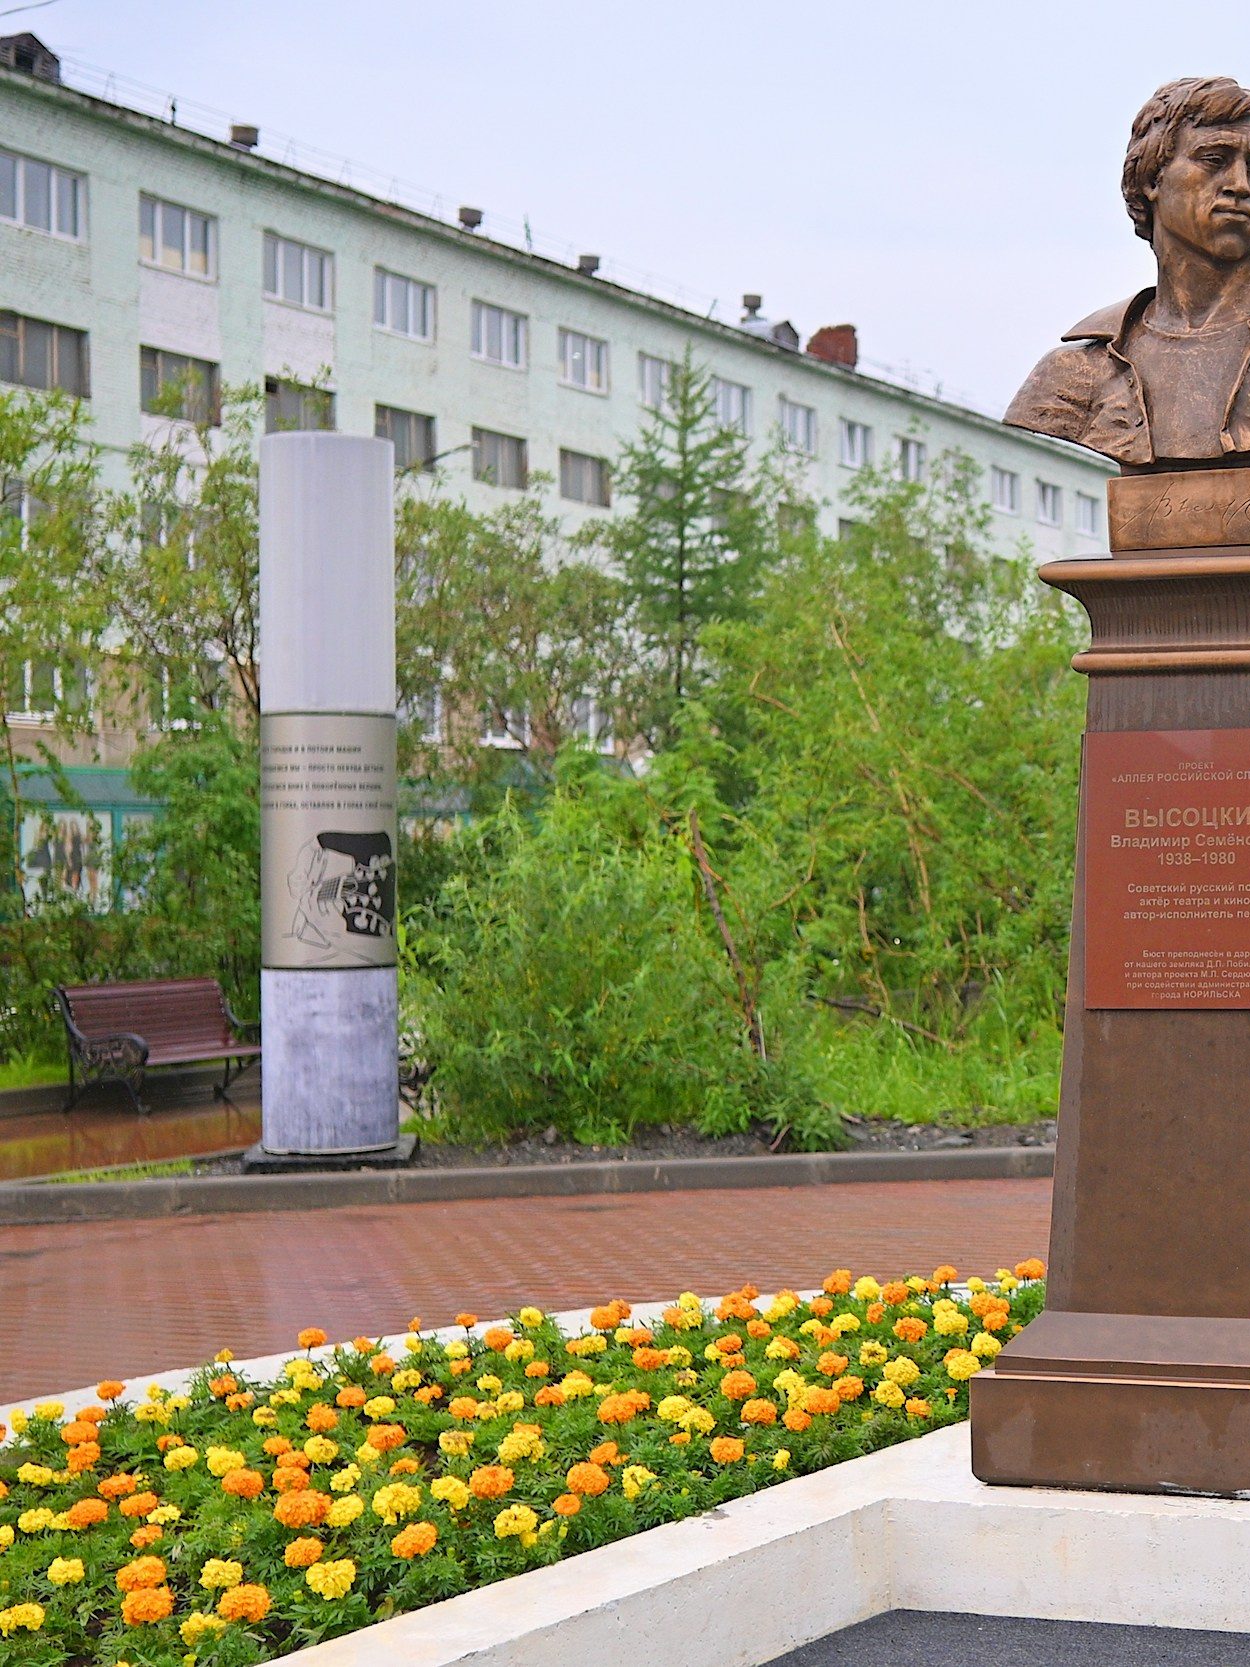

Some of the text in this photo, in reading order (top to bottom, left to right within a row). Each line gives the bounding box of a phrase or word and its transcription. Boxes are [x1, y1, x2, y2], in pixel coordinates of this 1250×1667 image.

[1178, 761, 1215, 770] ПРОЕКТ
[1111, 773, 1154, 783] «АЛЛЕЯ
[1157, 769, 1233, 782] РОССИЙСКОЙ
[1110, 834, 1190, 849] Владимир
[1127, 882, 1187, 894] Советский
[1189, 882, 1235, 895] русский
[1139, 897, 1170, 907] актёр
[1173, 897, 1210, 907] театра
[1123, 910, 1233, 920] автор-исполнитель
[1142, 950, 1165, 958] Бюст
[1234, 950, 1250, 959] дар
[1132, 971, 1162, 979] автора
[1164, 971, 1199, 979] проекта
[1127, 981, 1142, 989] при
[1144, 980, 1195, 989] содействии
[1183, 990, 1241, 999] НОРИЛЬСКА
